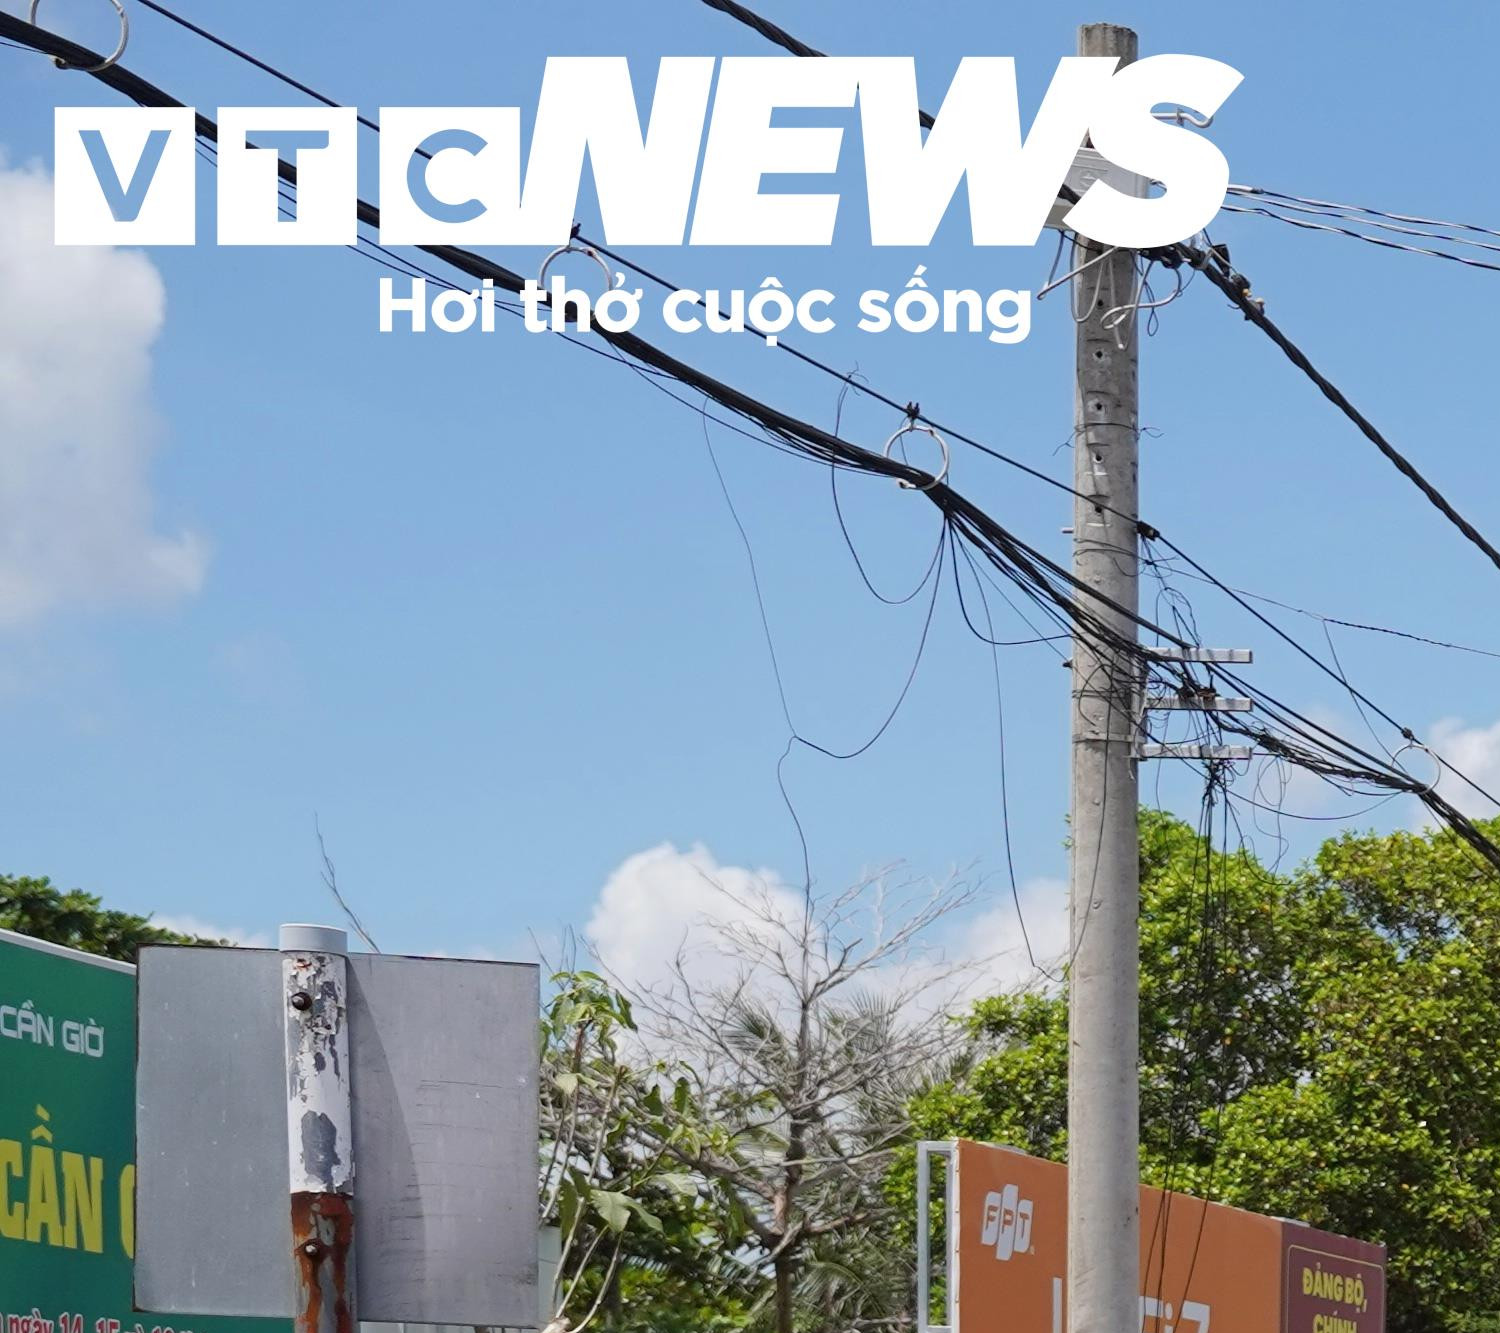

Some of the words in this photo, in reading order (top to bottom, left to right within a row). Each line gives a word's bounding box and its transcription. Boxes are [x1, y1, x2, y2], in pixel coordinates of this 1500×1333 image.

[62, 1017, 105, 1058] GIỜ
[0, 1103, 104, 1254] CẦN
[983, 1196, 1031, 1250] FPT
[1302, 1261, 1343, 1301] ĐẢNG
[1345, 1273, 1368, 1313] BỘ,
